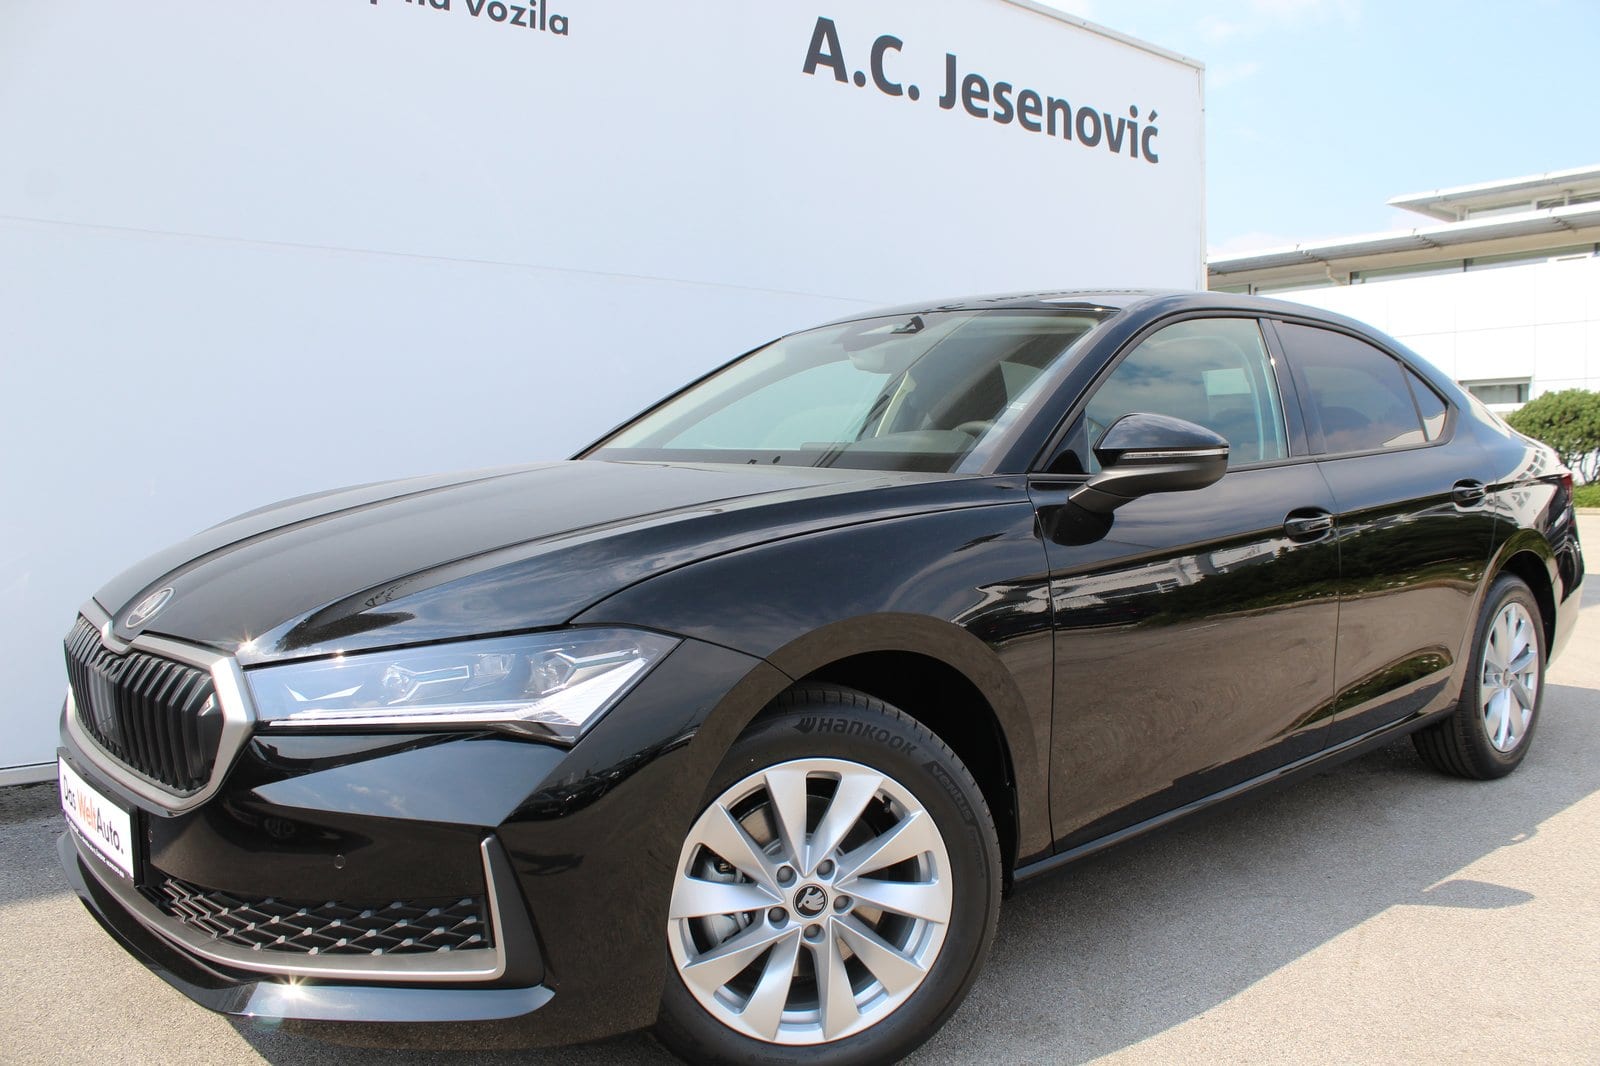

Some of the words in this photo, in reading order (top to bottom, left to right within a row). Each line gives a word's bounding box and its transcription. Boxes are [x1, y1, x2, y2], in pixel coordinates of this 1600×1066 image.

[464, 0, 569, 36] vozila
[802, 16, 920, 101] A.C.
[939, 53, 1159, 164] Jesenović
